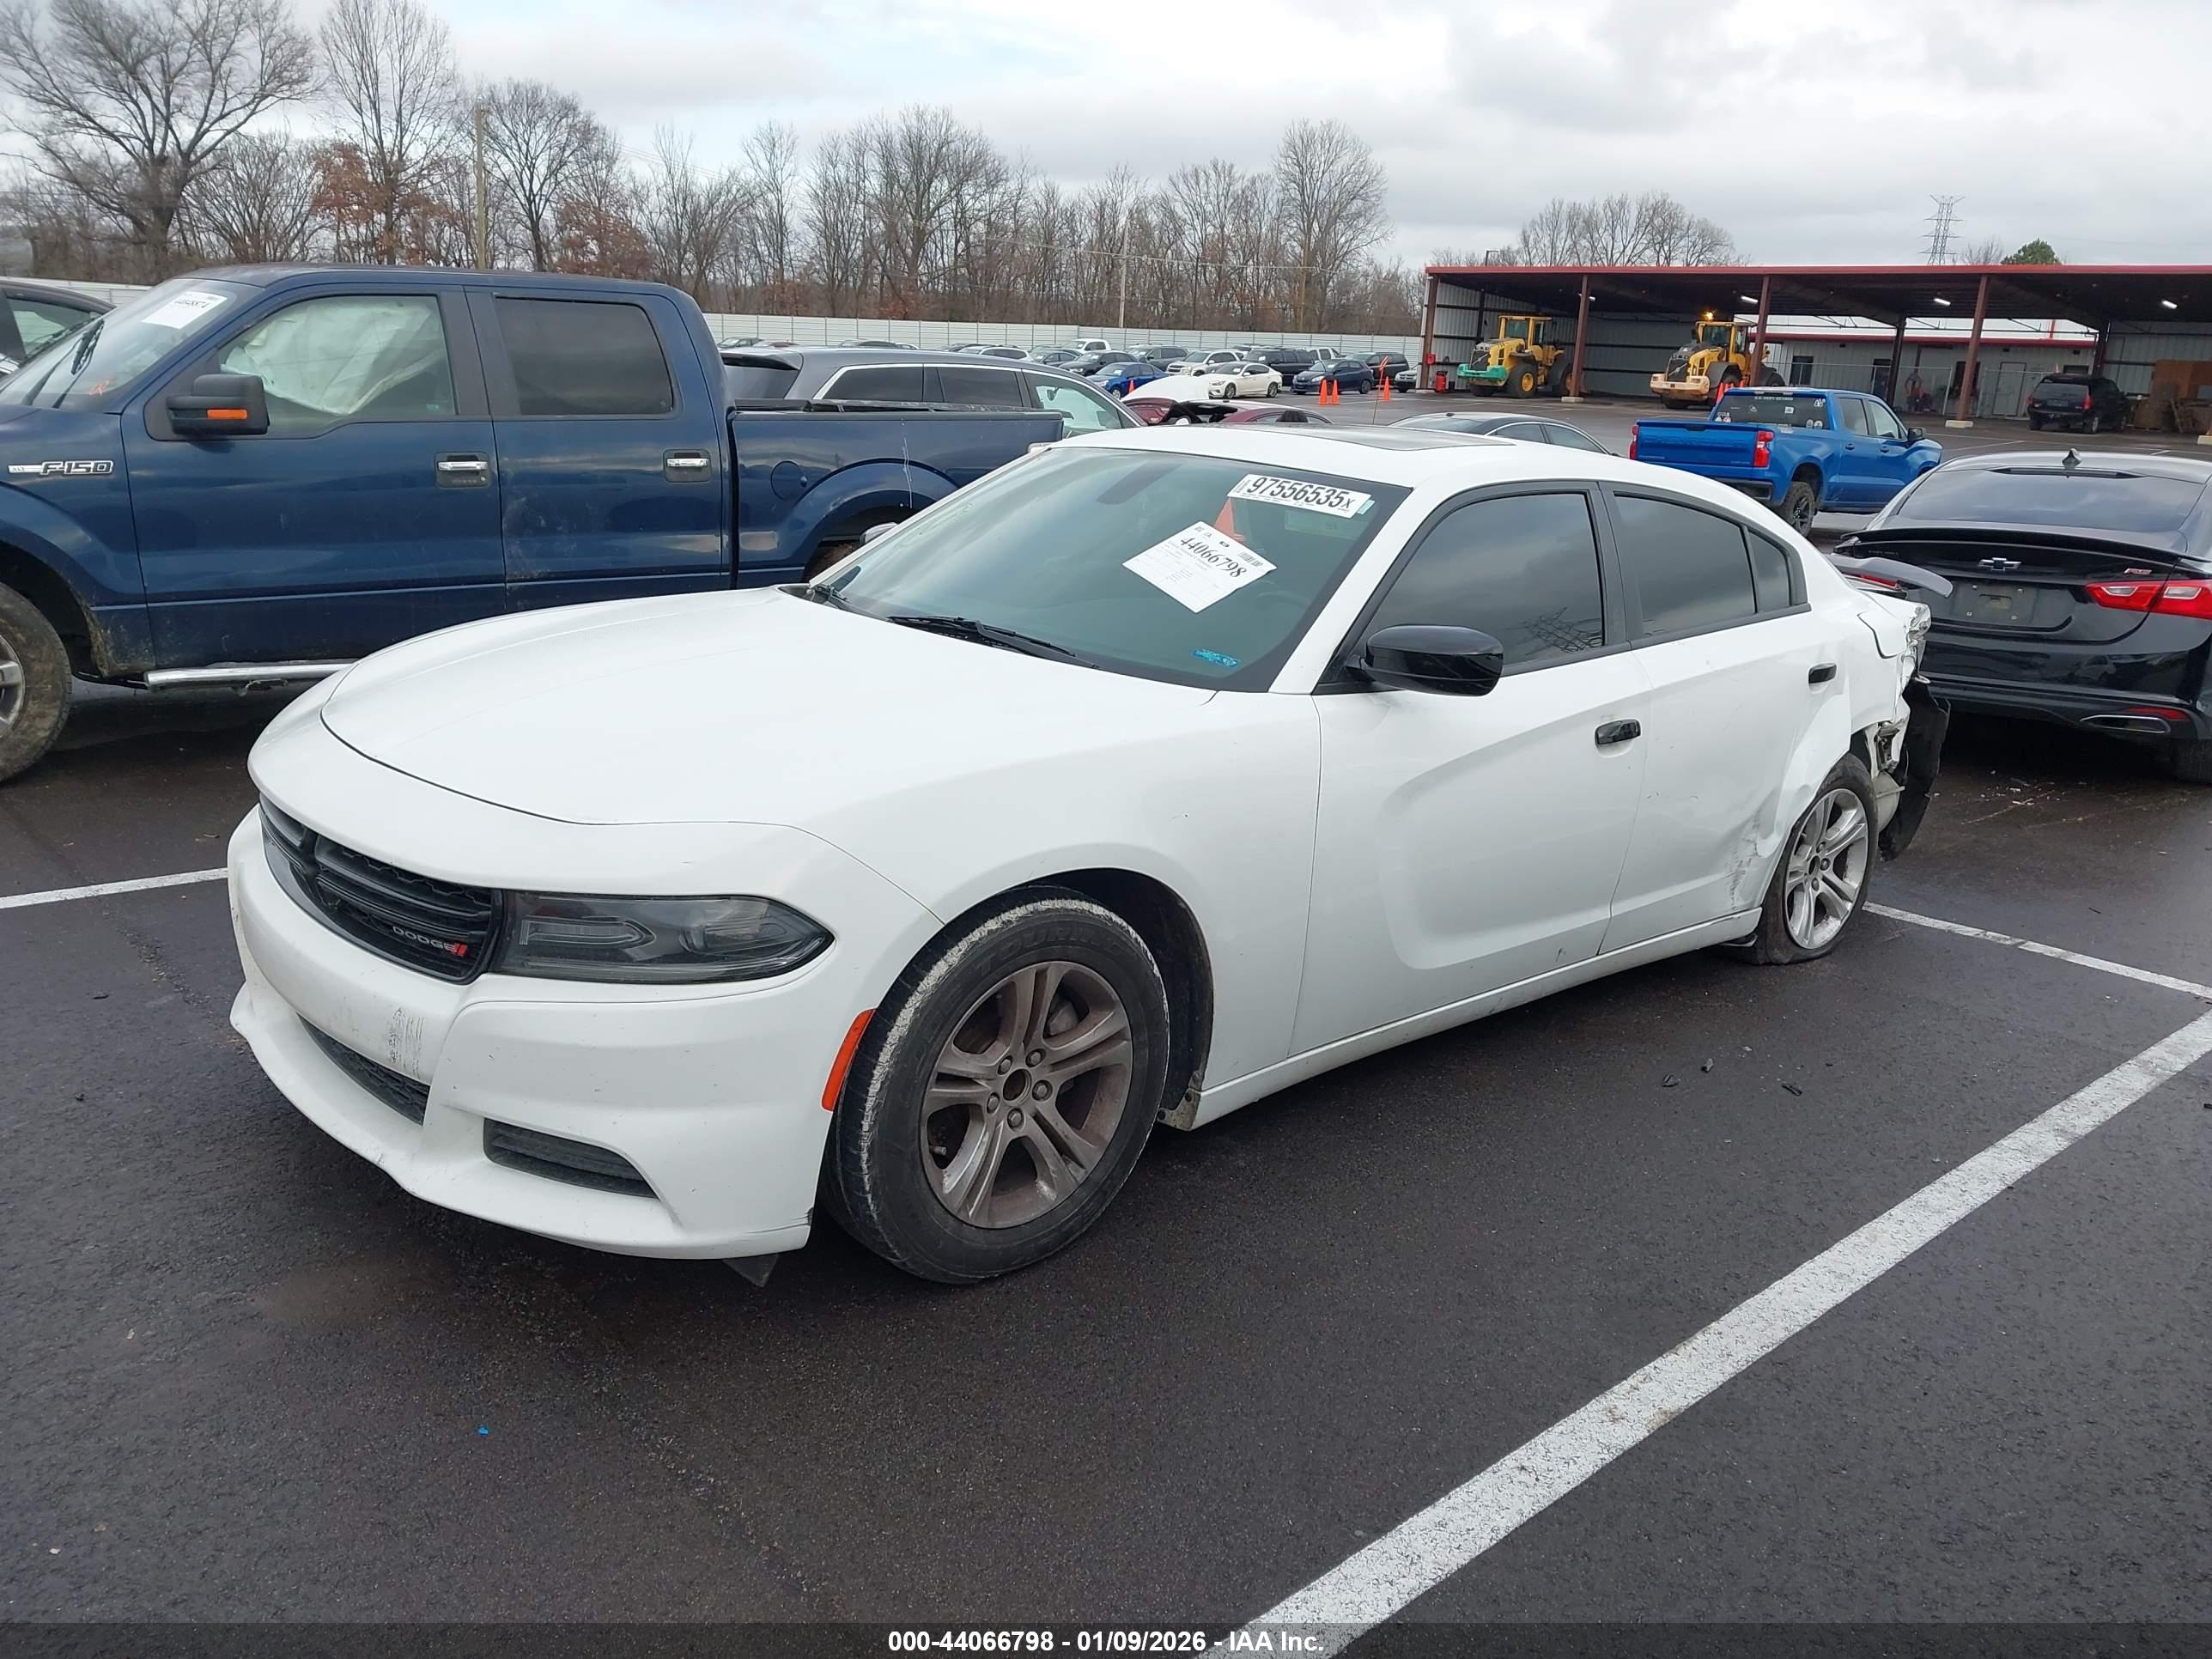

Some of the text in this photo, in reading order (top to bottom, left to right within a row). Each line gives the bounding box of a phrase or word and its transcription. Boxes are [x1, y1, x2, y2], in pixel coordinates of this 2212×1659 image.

[40, 460, 113, 476] F-150
[1180, 536, 1247, 578] 44066798
[392, 926, 458, 953] DODGE
